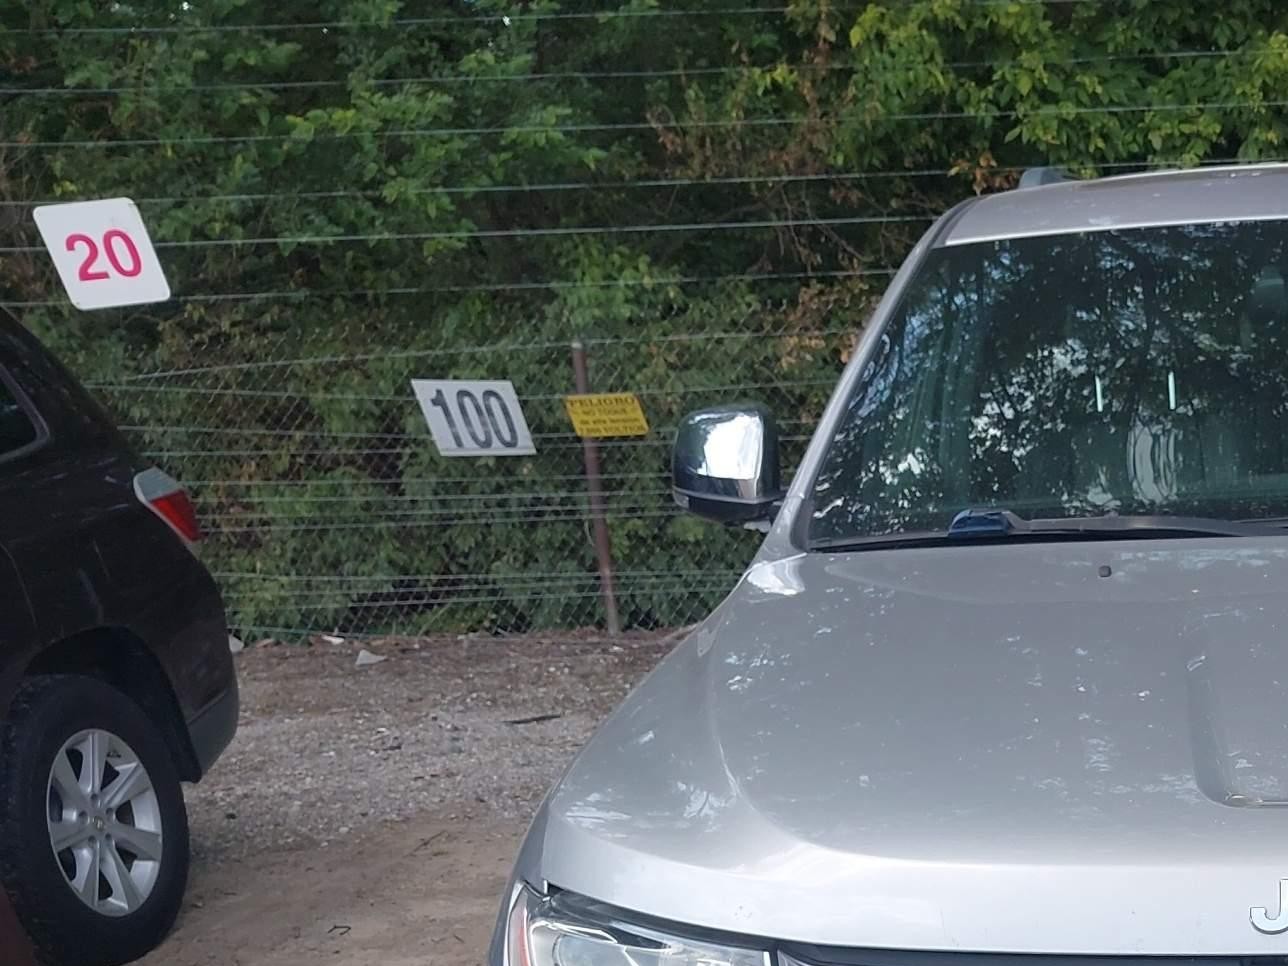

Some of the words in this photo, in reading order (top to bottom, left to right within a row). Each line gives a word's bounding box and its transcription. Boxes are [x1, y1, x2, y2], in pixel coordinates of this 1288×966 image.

[65, 229, 142, 281] 20
[431, 388, 518, 449] 100
[567, 396, 636, 408] PELIGRO
